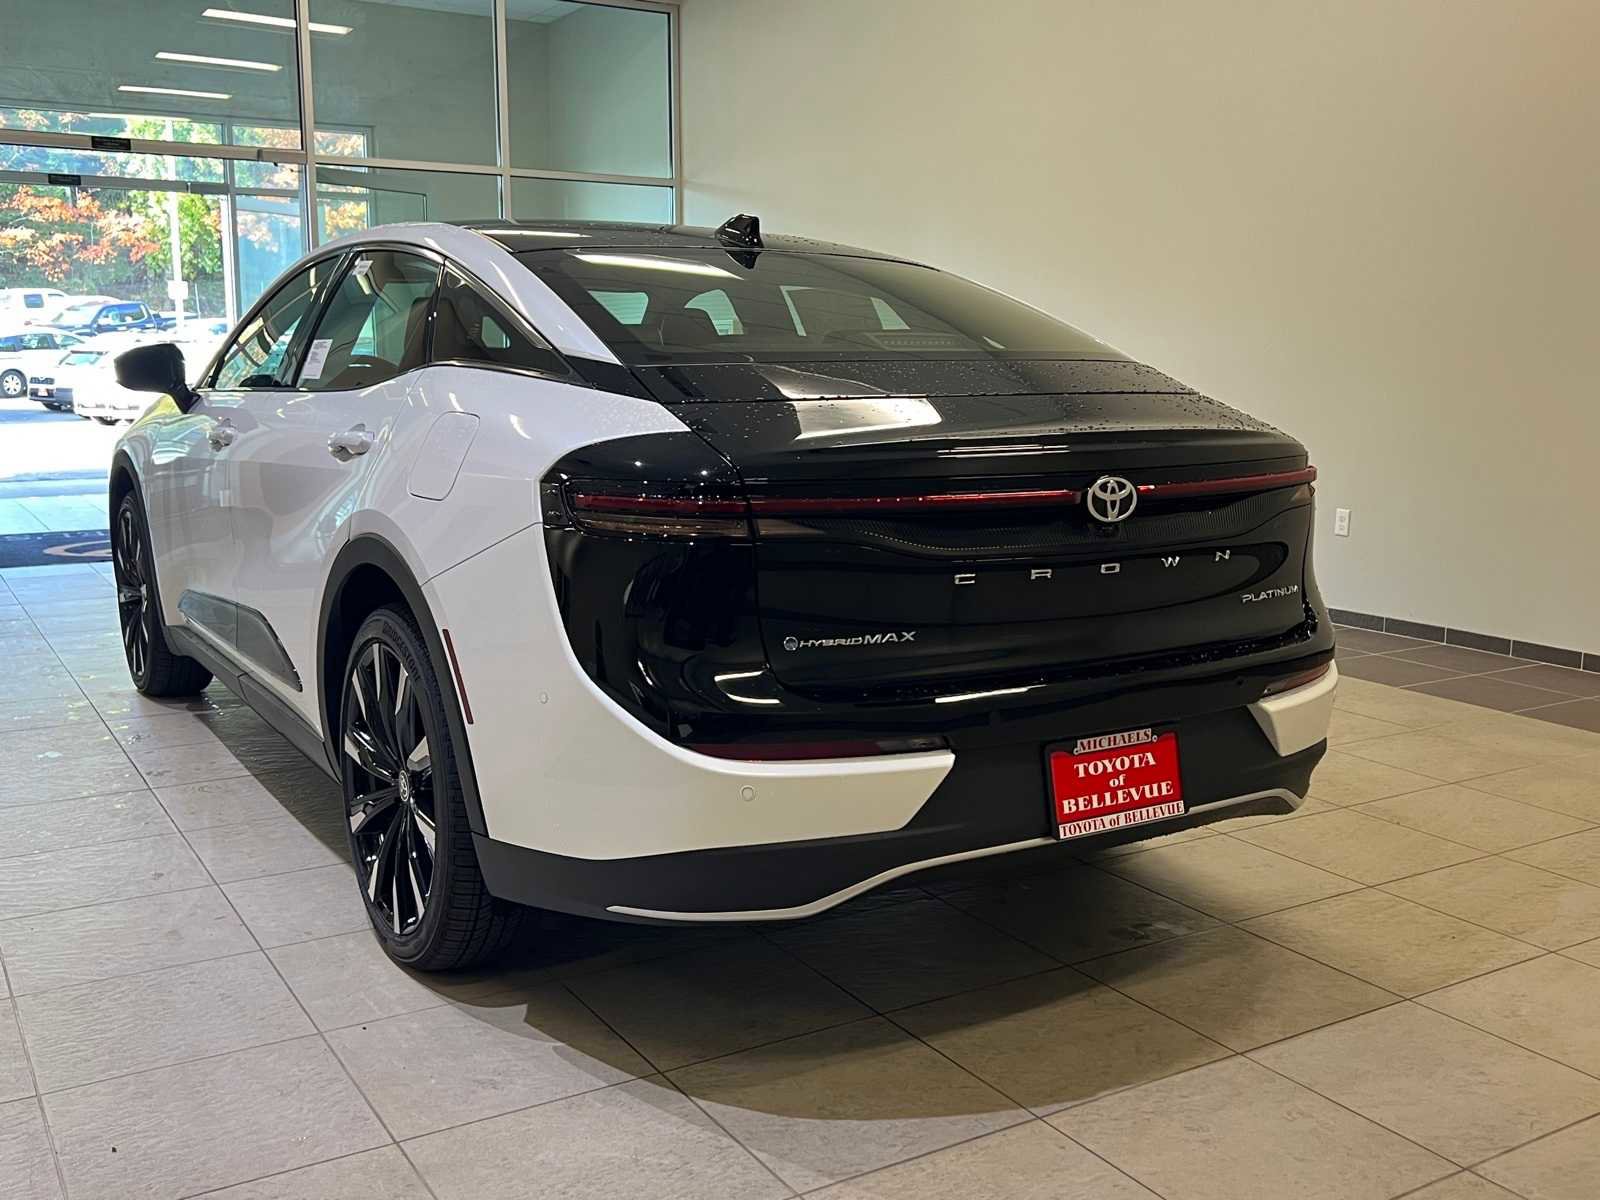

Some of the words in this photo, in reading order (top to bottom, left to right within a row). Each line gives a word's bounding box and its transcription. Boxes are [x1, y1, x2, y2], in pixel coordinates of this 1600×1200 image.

[954, 549, 1231, 585] CROWN
[1241, 585, 1299, 603] PLATINUM
[1079, 728, 1151, 751] MICHAELS
[1074, 752, 1156, 778] TOYOTA
[1109, 774, 1126, 788] of
[1062, 781, 1174, 815] BELLEVUE
[1061, 818, 1106, 837] TOYOTA
[1109, 816, 1121, 828] of
[1124, 801, 1184, 825] BELLEVUE
